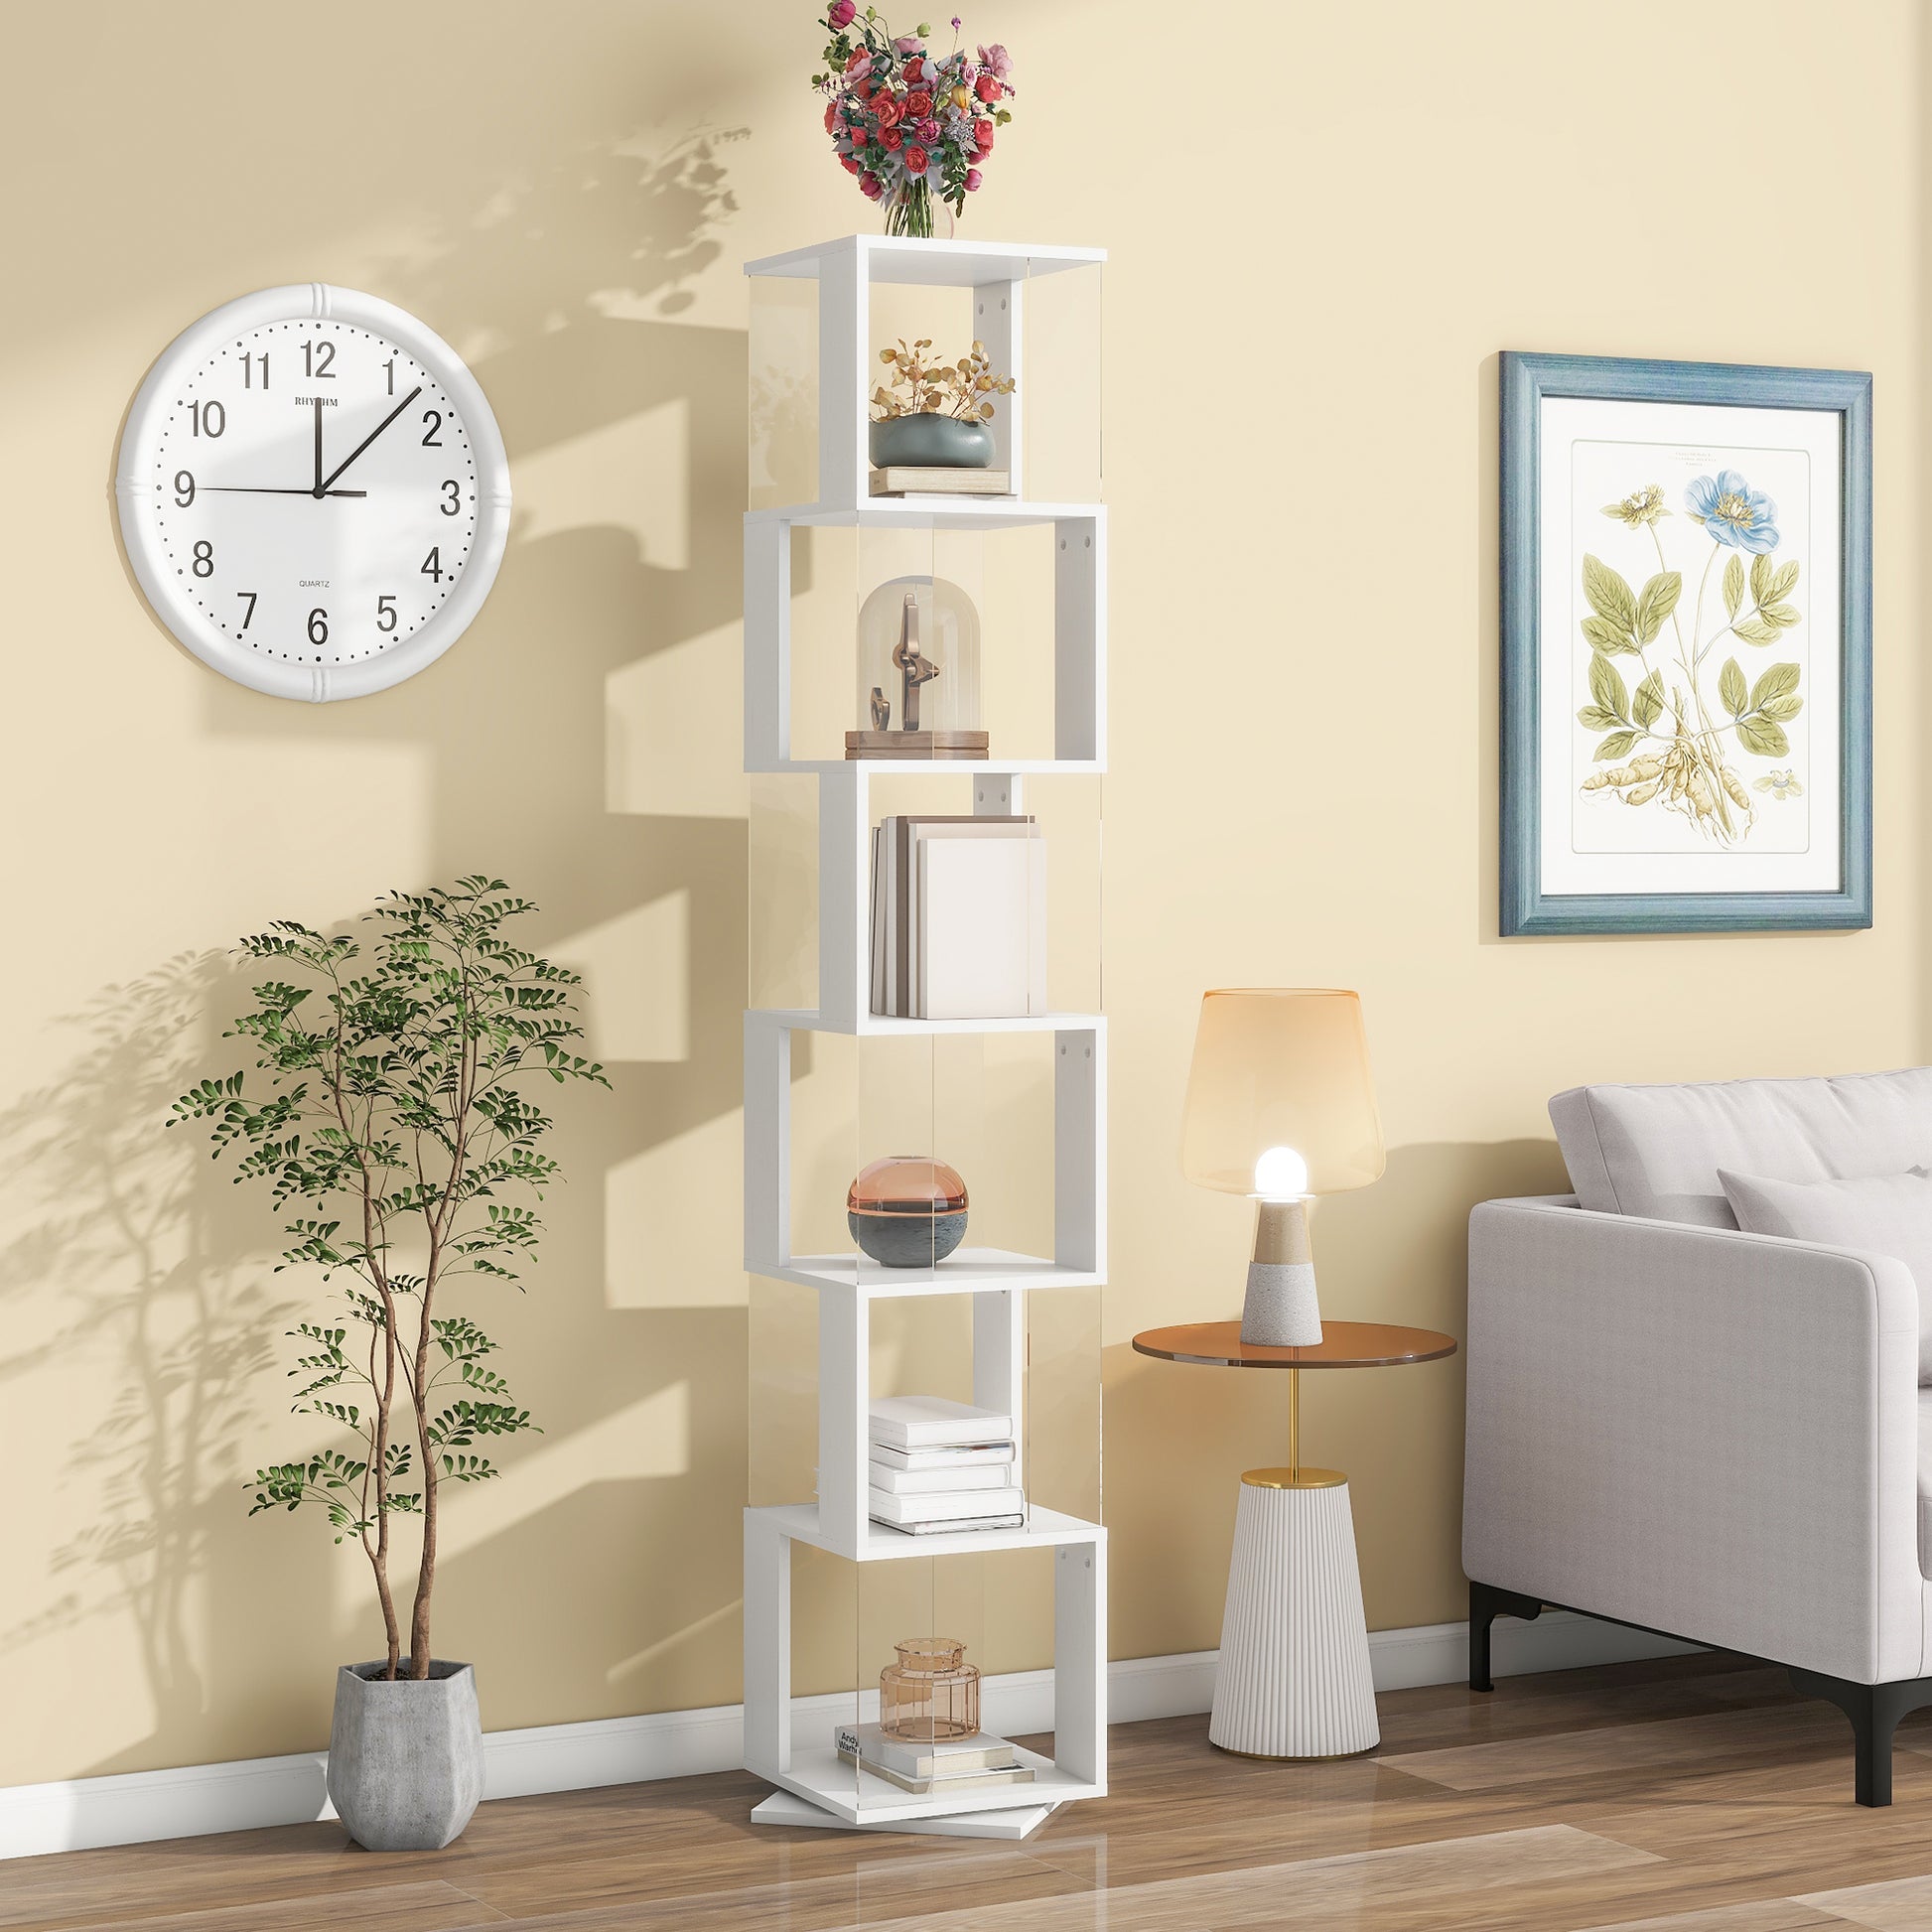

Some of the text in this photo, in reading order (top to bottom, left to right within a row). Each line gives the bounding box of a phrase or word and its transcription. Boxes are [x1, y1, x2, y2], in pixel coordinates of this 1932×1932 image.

[238, 350, 270, 389] 11
[300, 339, 336, 378] 12
[381, 358, 394, 396] 1
[187, 399, 226, 439] 10
[294, 396, 339, 407] RHYHM
[422, 409, 443, 448] 2
[174, 470, 197, 508] 9
[440, 480, 461, 516] 3
[192, 539, 214, 579] 8
[420, 546, 443, 584] 4
[236, 592, 258, 629] 7
[307, 608, 329, 645] 6
[376, 595, 397, 632] 5
[841, 1732, 859, 1747] Andy
